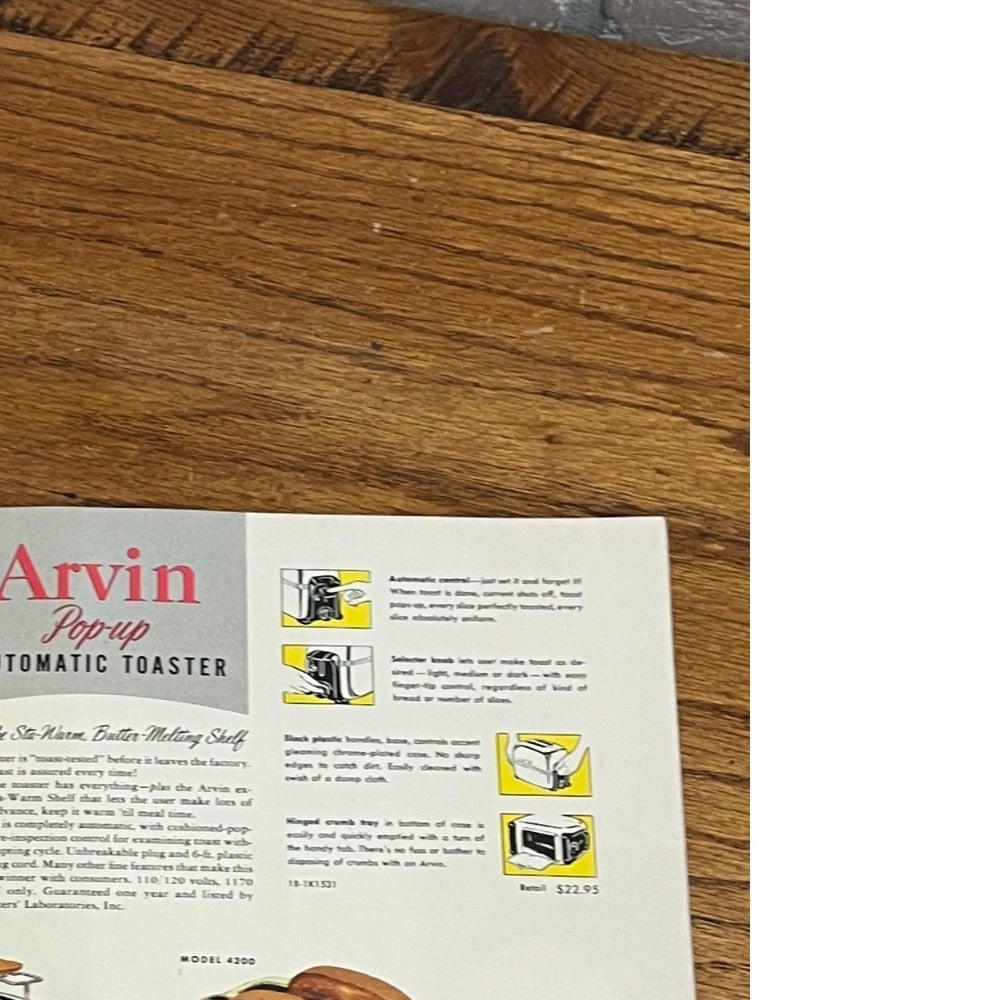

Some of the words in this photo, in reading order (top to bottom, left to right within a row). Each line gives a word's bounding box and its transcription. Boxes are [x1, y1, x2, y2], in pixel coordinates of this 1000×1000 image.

[41, 604, 151, 650] Pop-up
[123, 655, 227, 677] TOASTER
[91, 725, 204, 749] Butter-Melting
[206, 728, 249, 751] Shelf
[520, 883, 547, 893] Retail
[556, 884, 600, 895] $22.95
[180, 955, 221, 965] MODEL
[226, 956, 256, 966] 4200
